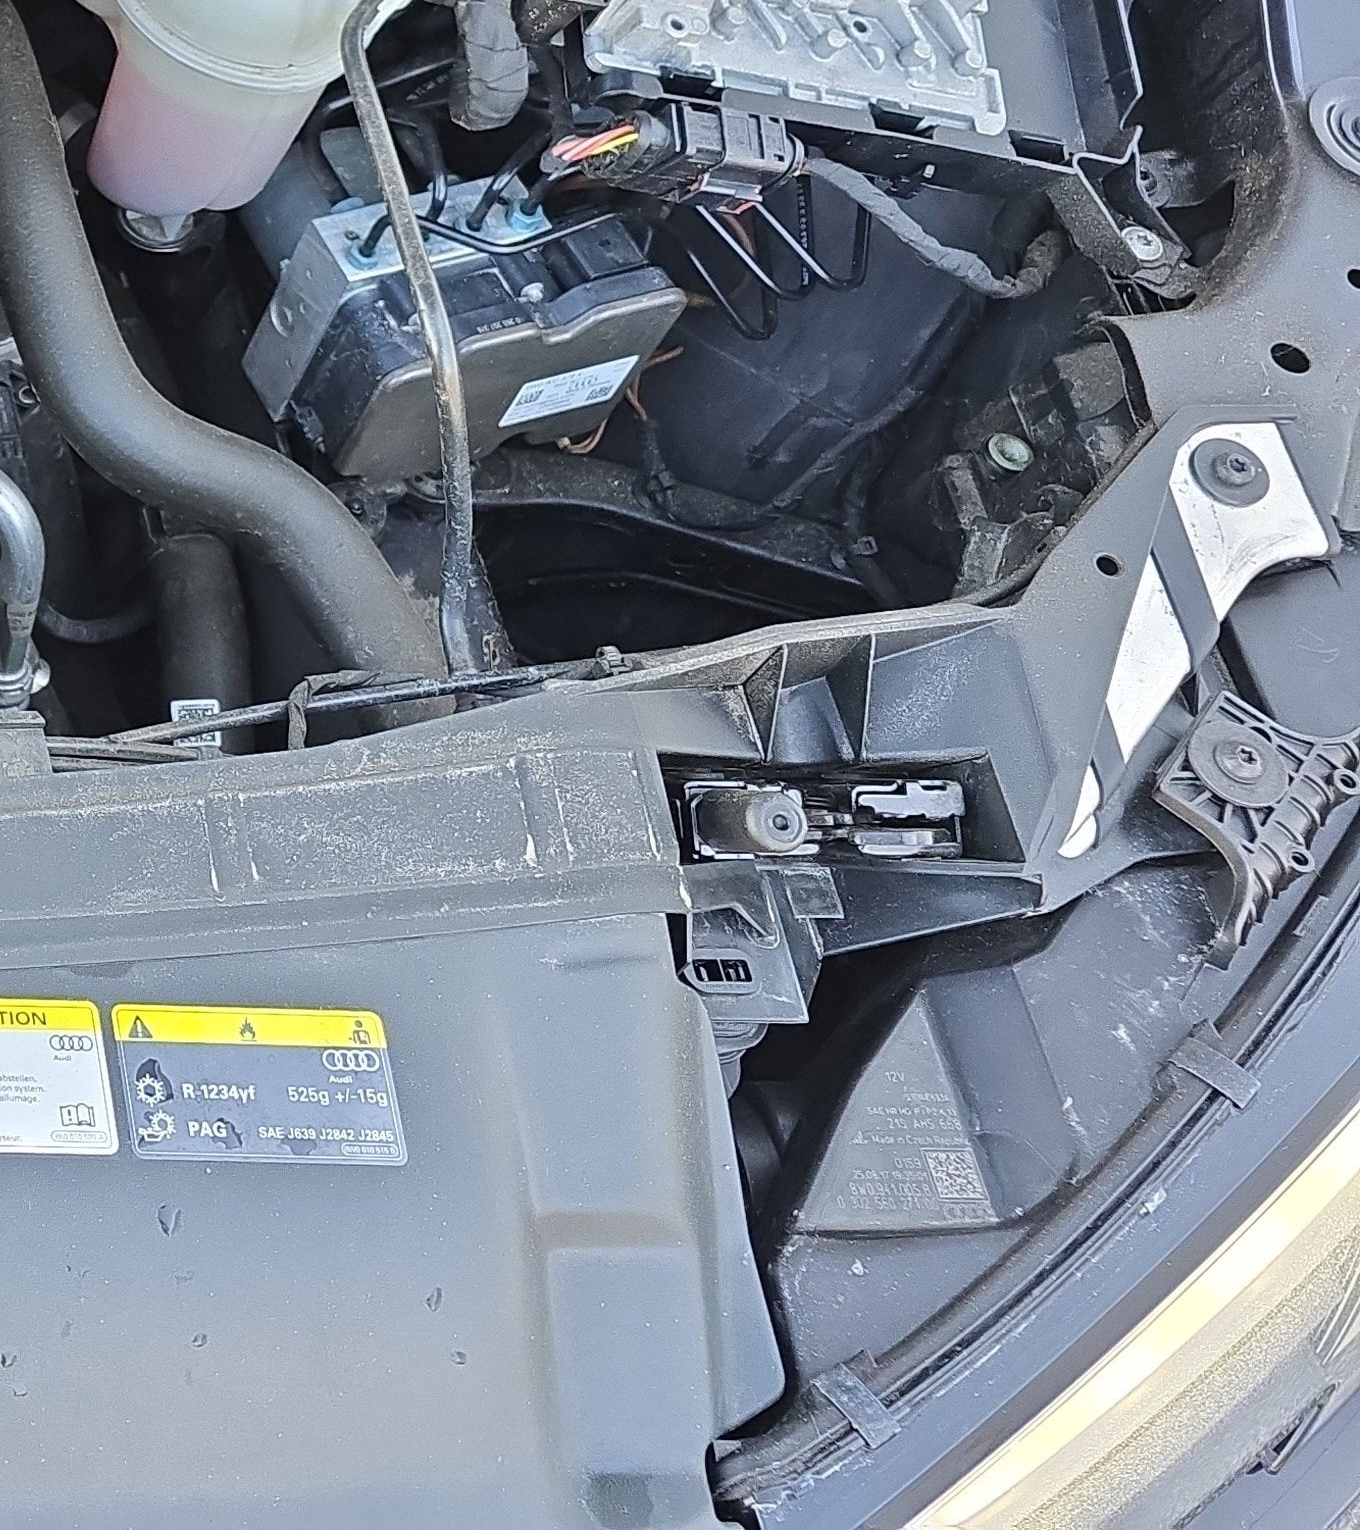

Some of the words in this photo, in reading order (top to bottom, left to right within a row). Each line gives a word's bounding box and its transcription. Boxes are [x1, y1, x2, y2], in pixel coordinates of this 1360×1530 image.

[52, 1054, 72, 1062] Audi
[329, 1075, 353, 1084] Audi
[885, 1071, 905, 1082] 12V
[288, 1086, 330, 1105] 525g
[334, 1088, 387, 1107] +/-15g
[188, 1121, 227, 1137] PAG
[259, 1127, 285, 1139] SAE
[286, 1128, 316, 1140] J639
[319, 1128, 355, 1141] J2842
[358, 1129, 393, 1142] J2845
[905, 1135, 935, 1145] Czech
